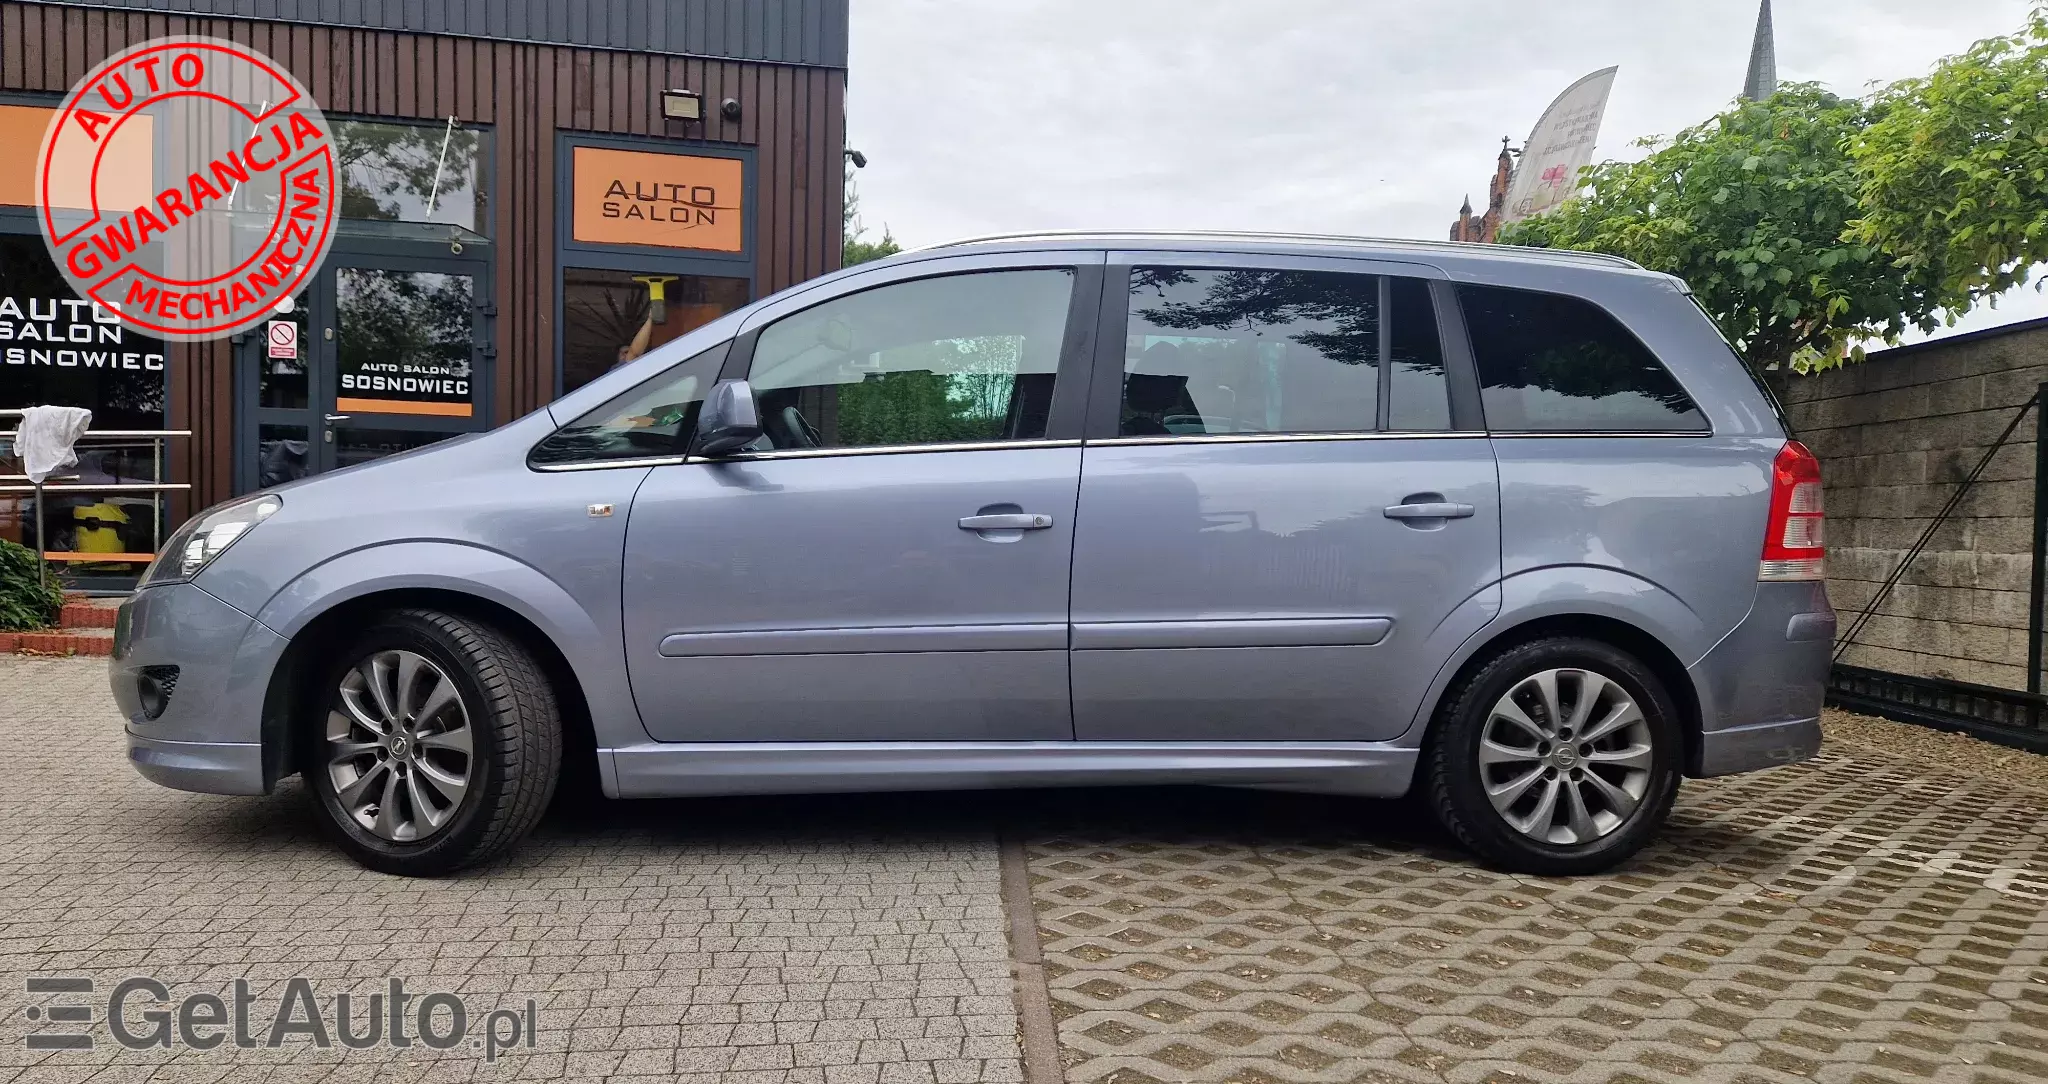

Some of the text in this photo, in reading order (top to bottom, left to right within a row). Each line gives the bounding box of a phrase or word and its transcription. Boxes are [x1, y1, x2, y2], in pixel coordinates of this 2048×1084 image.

[604, 179, 715, 206] AUTO
[602, 202, 715, 225] SALON
[0, 296, 121, 324] AUTO
[0, 320, 122, 345] SALON
[360, 362, 450, 375] AUTO SALON
[341, 373, 469, 395] SOSNOWIEC
